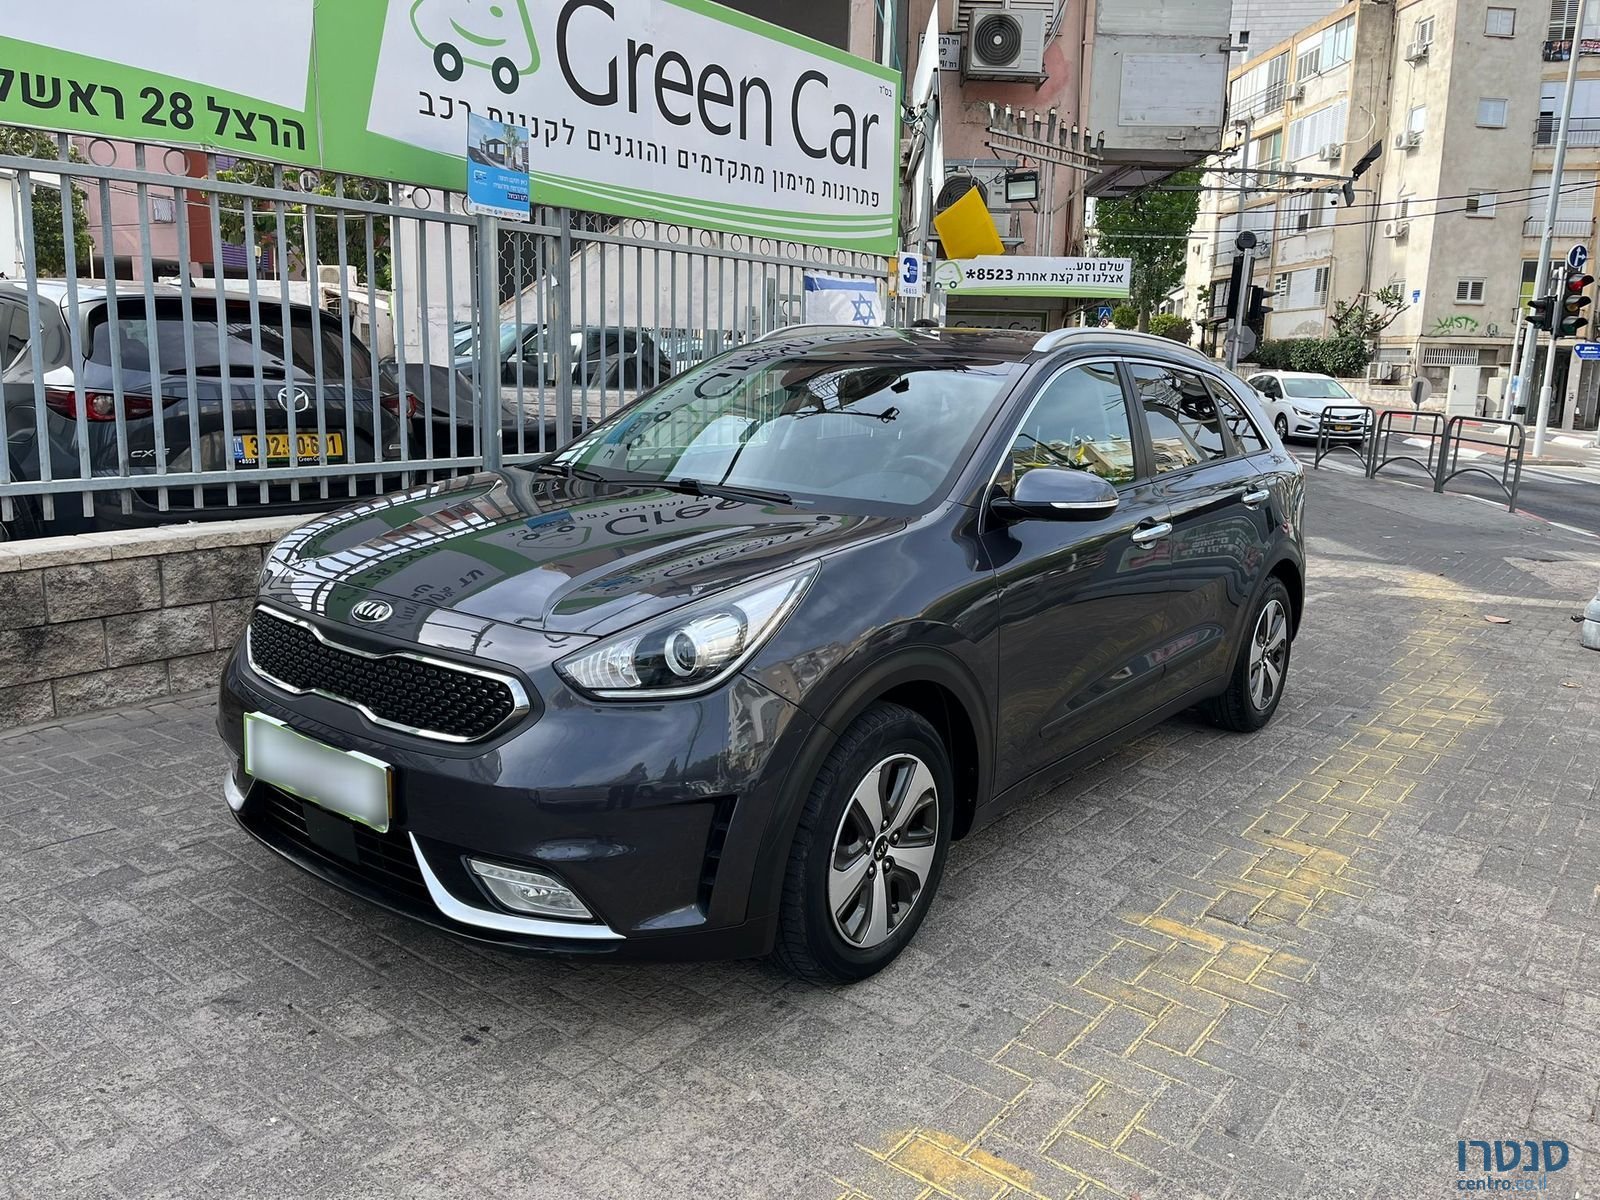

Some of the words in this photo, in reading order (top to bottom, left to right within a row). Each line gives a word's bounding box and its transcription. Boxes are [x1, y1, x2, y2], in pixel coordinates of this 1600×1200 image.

[556, 0, 772, 146] Green
[791, 70, 879, 169] Car
[140, 86, 194, 130] 28
[206, 95, 305, 150] הרצל
[588, 129, 667, 165] והוגנים
[678, 149, 764, 184] מתקדמים
[773, 169, 815, 195] מימון
[822, 180, 880, 208] פתרונות
[903, 257, 918, 284] 3
[1017, 271, 1047, 281] אחרת
[1050, 271, 1073, 284] קצת
[1077, 272, 1089, 282] זה
[1092, 272, 1124, 283] אצלנו
[1099, 261, 1124, 272] שלם
[353, 600, 386, 620] KIA
